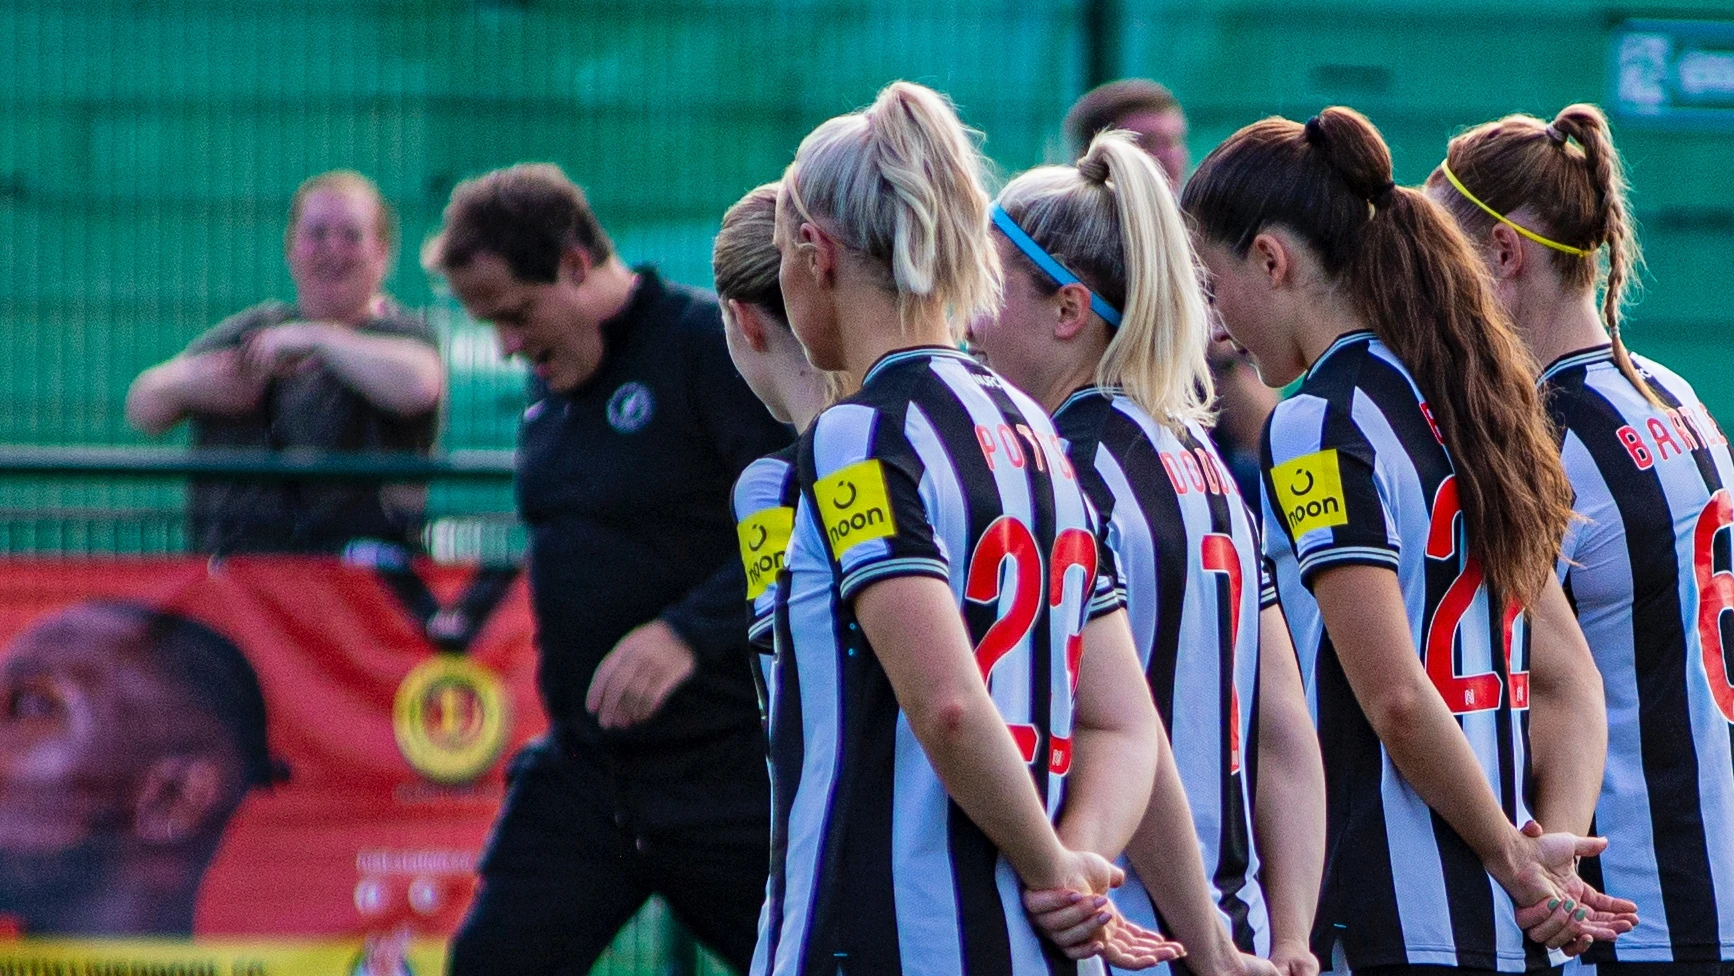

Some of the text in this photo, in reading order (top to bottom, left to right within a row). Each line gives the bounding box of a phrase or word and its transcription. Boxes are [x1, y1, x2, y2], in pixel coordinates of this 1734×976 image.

[1160, 447, 1242, 495] DODD
[829, 507, 885, 546] noon
[1289, 496, 1340, 530] noon
[748, 551, 786, 586] noon
[1200, 531, 1244, 776] 7
